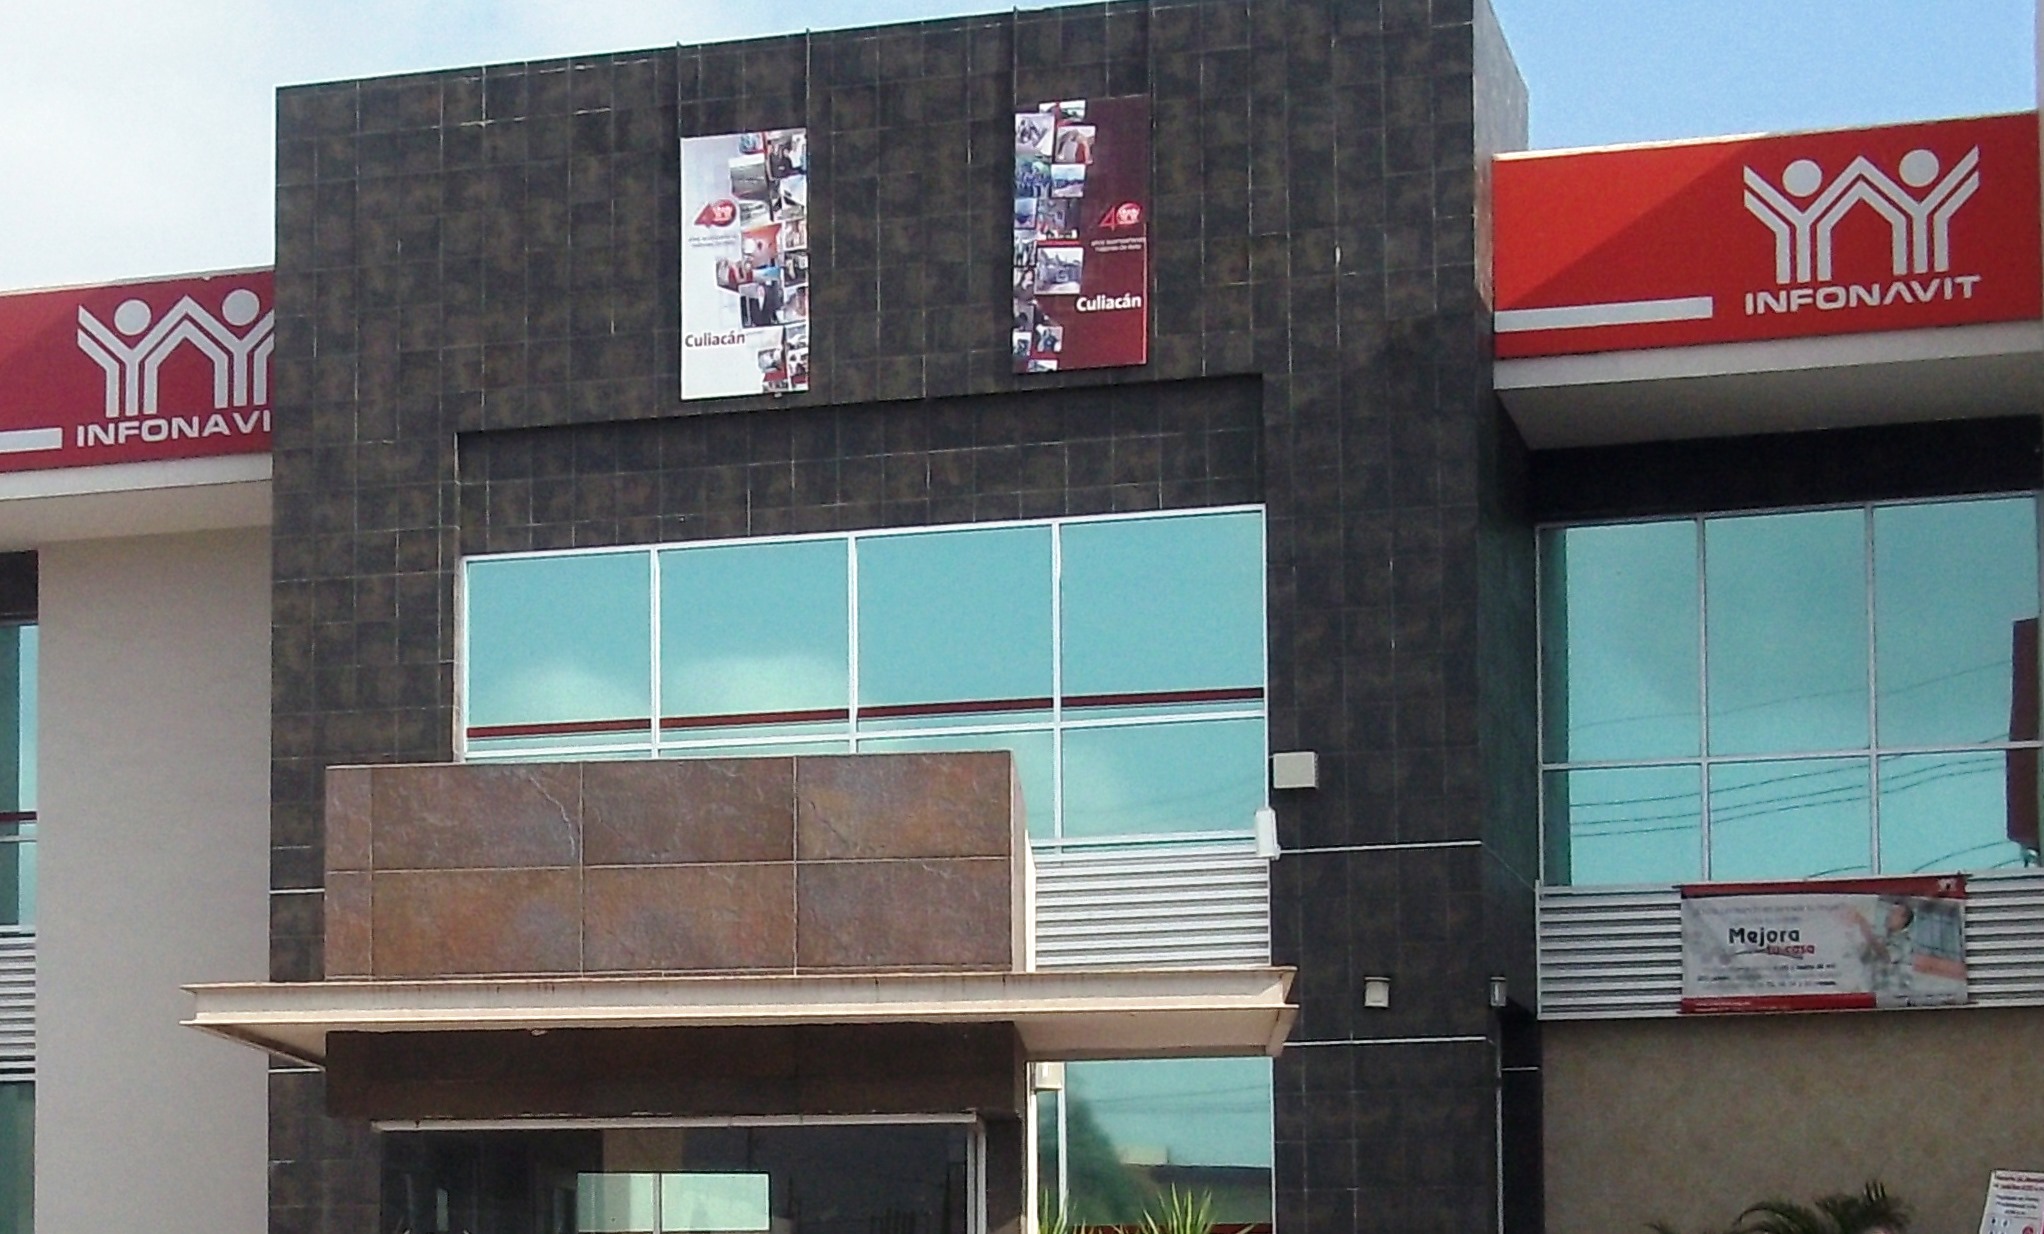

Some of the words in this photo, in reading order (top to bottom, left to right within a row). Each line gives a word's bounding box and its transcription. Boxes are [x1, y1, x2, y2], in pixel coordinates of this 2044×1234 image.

[1076, 293, 1142, 312] Culiacán
[1744, 274, 1981, 315] INFONAVIT
[684, 330, 745, 348] Culiacán
[1728, 926, 1800, 947] Mejora
